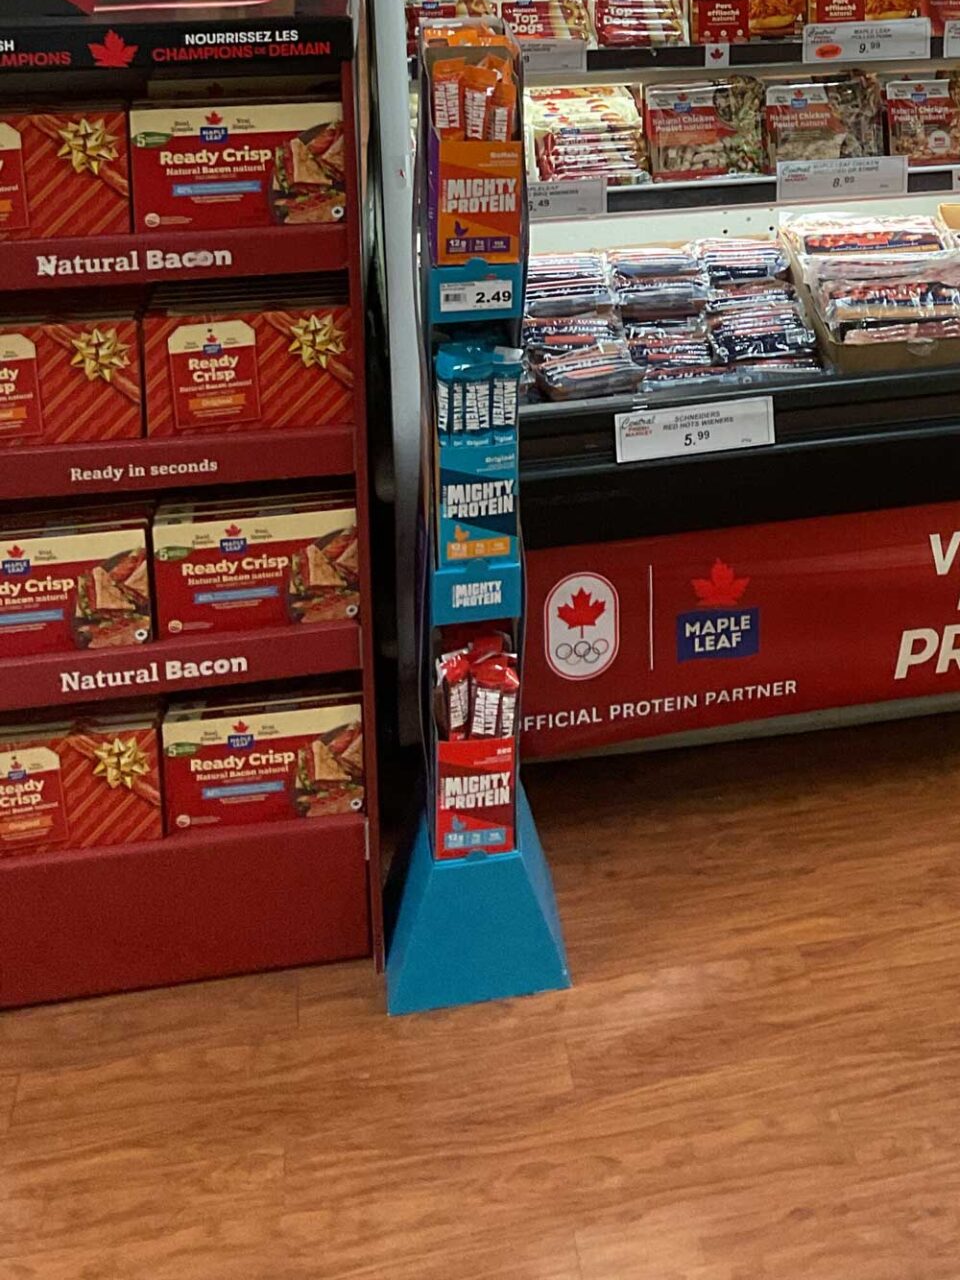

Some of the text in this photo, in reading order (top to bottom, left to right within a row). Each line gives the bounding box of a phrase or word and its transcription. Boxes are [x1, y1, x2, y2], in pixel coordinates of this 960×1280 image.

[513, 13, 539, 26] Top
[609, 7, 633, 16] Top
[509, 22, 544, 35] Dogs
[184, 30, 298, 45] NOURRISSEZ LES
[152, 45, 252, 61] CHAMPIONS
[269, 42, 330, 57] DEMAIN
[858, 40, 881, 54] 9.99
[0, 51, 72, 67] MPIONS
[682, 113, 715, 124] Chicken
[798, 111, 830, 120] Chicken
[136, 134, 146, 147] 5
[160, 145, 272, 166] Ready Crisp
[166, 165, 231, 176] Natural Bacon
[448, 177, 517, 199] MIGHTY
[447, 194, 516, 214] PROTEIN
[37, 248, 232, 276] Natural Bacon
[475, 290, 512, 304] 2.49
[188, 354, 239, 371] Ready
[192, 368, 235, 384] Crisp
[674, 411, 721, 422] SCHNEIDERS
[663, 423, 678, 431] RED
[680, 420, 699, 430] HOTS
[684, 430, 710, 447] 5.99
[71, 458, 218, 483] Ready in seconds
[447, 479, 514, 505] MIGHTY
[447, 496, 514, 519] PROTEIN
[181, 553, 289, 577] Ready Crisp
[25, 575, 74, 592] Crisp
[187, 573, 250, 585] Natural Bacon
[454, 580, 502, 597] MIGHTY
[454, 591, 502, 608] PROTEIN
[684, 614, 751, 638] MAPLE
[694, 634, 742, 653] LEAF
[60, 656, 247, 693] Natural Bacon
[518, 706, 603, 732] FFICIAL
[609, 694, 698, 720] PROTEIN
[705, 679, 797, 705] PARTNER
[191, 749, 295, 772] Ready Crisp
[229, 769, 257, 779] Bacon
[445, 771, 511, 796] MIGHTY
[0, 790, 41, 808] Crisp
[444, 787, 511, 810] PROTEIN
